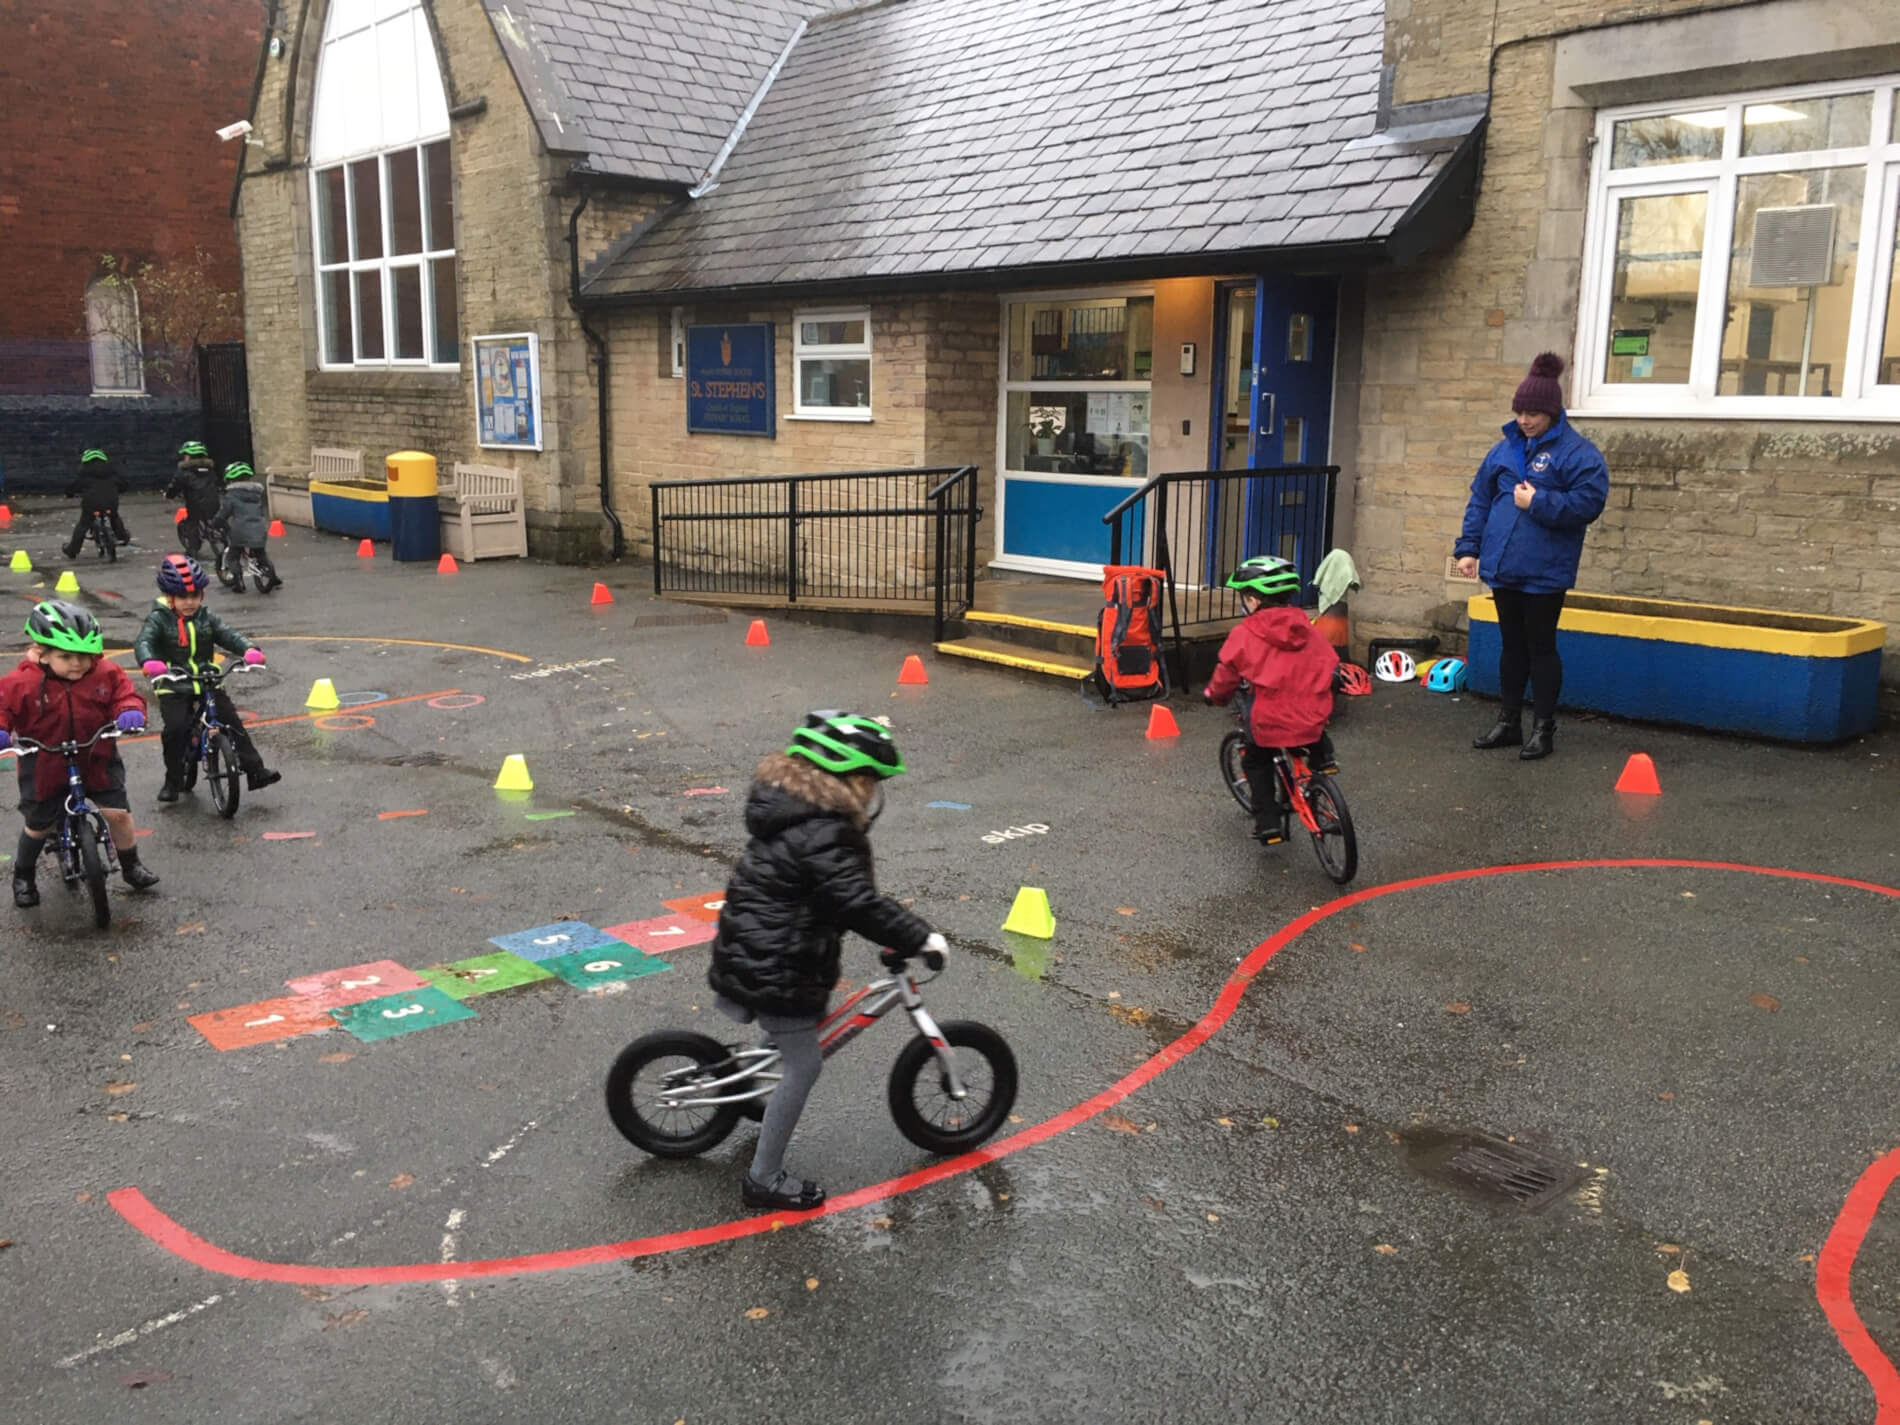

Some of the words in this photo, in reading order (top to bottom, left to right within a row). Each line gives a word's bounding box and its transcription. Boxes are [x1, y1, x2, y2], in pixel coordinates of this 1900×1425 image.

[981, 823, 1050, 844] skip
[533, 934, 570, 945] 5
[584, 961, 623, 972] 6
[341, 975, 381, 989] 2
[382, 1004, 424, 1019] 3
[244, 1013, 285, 1027] 1
